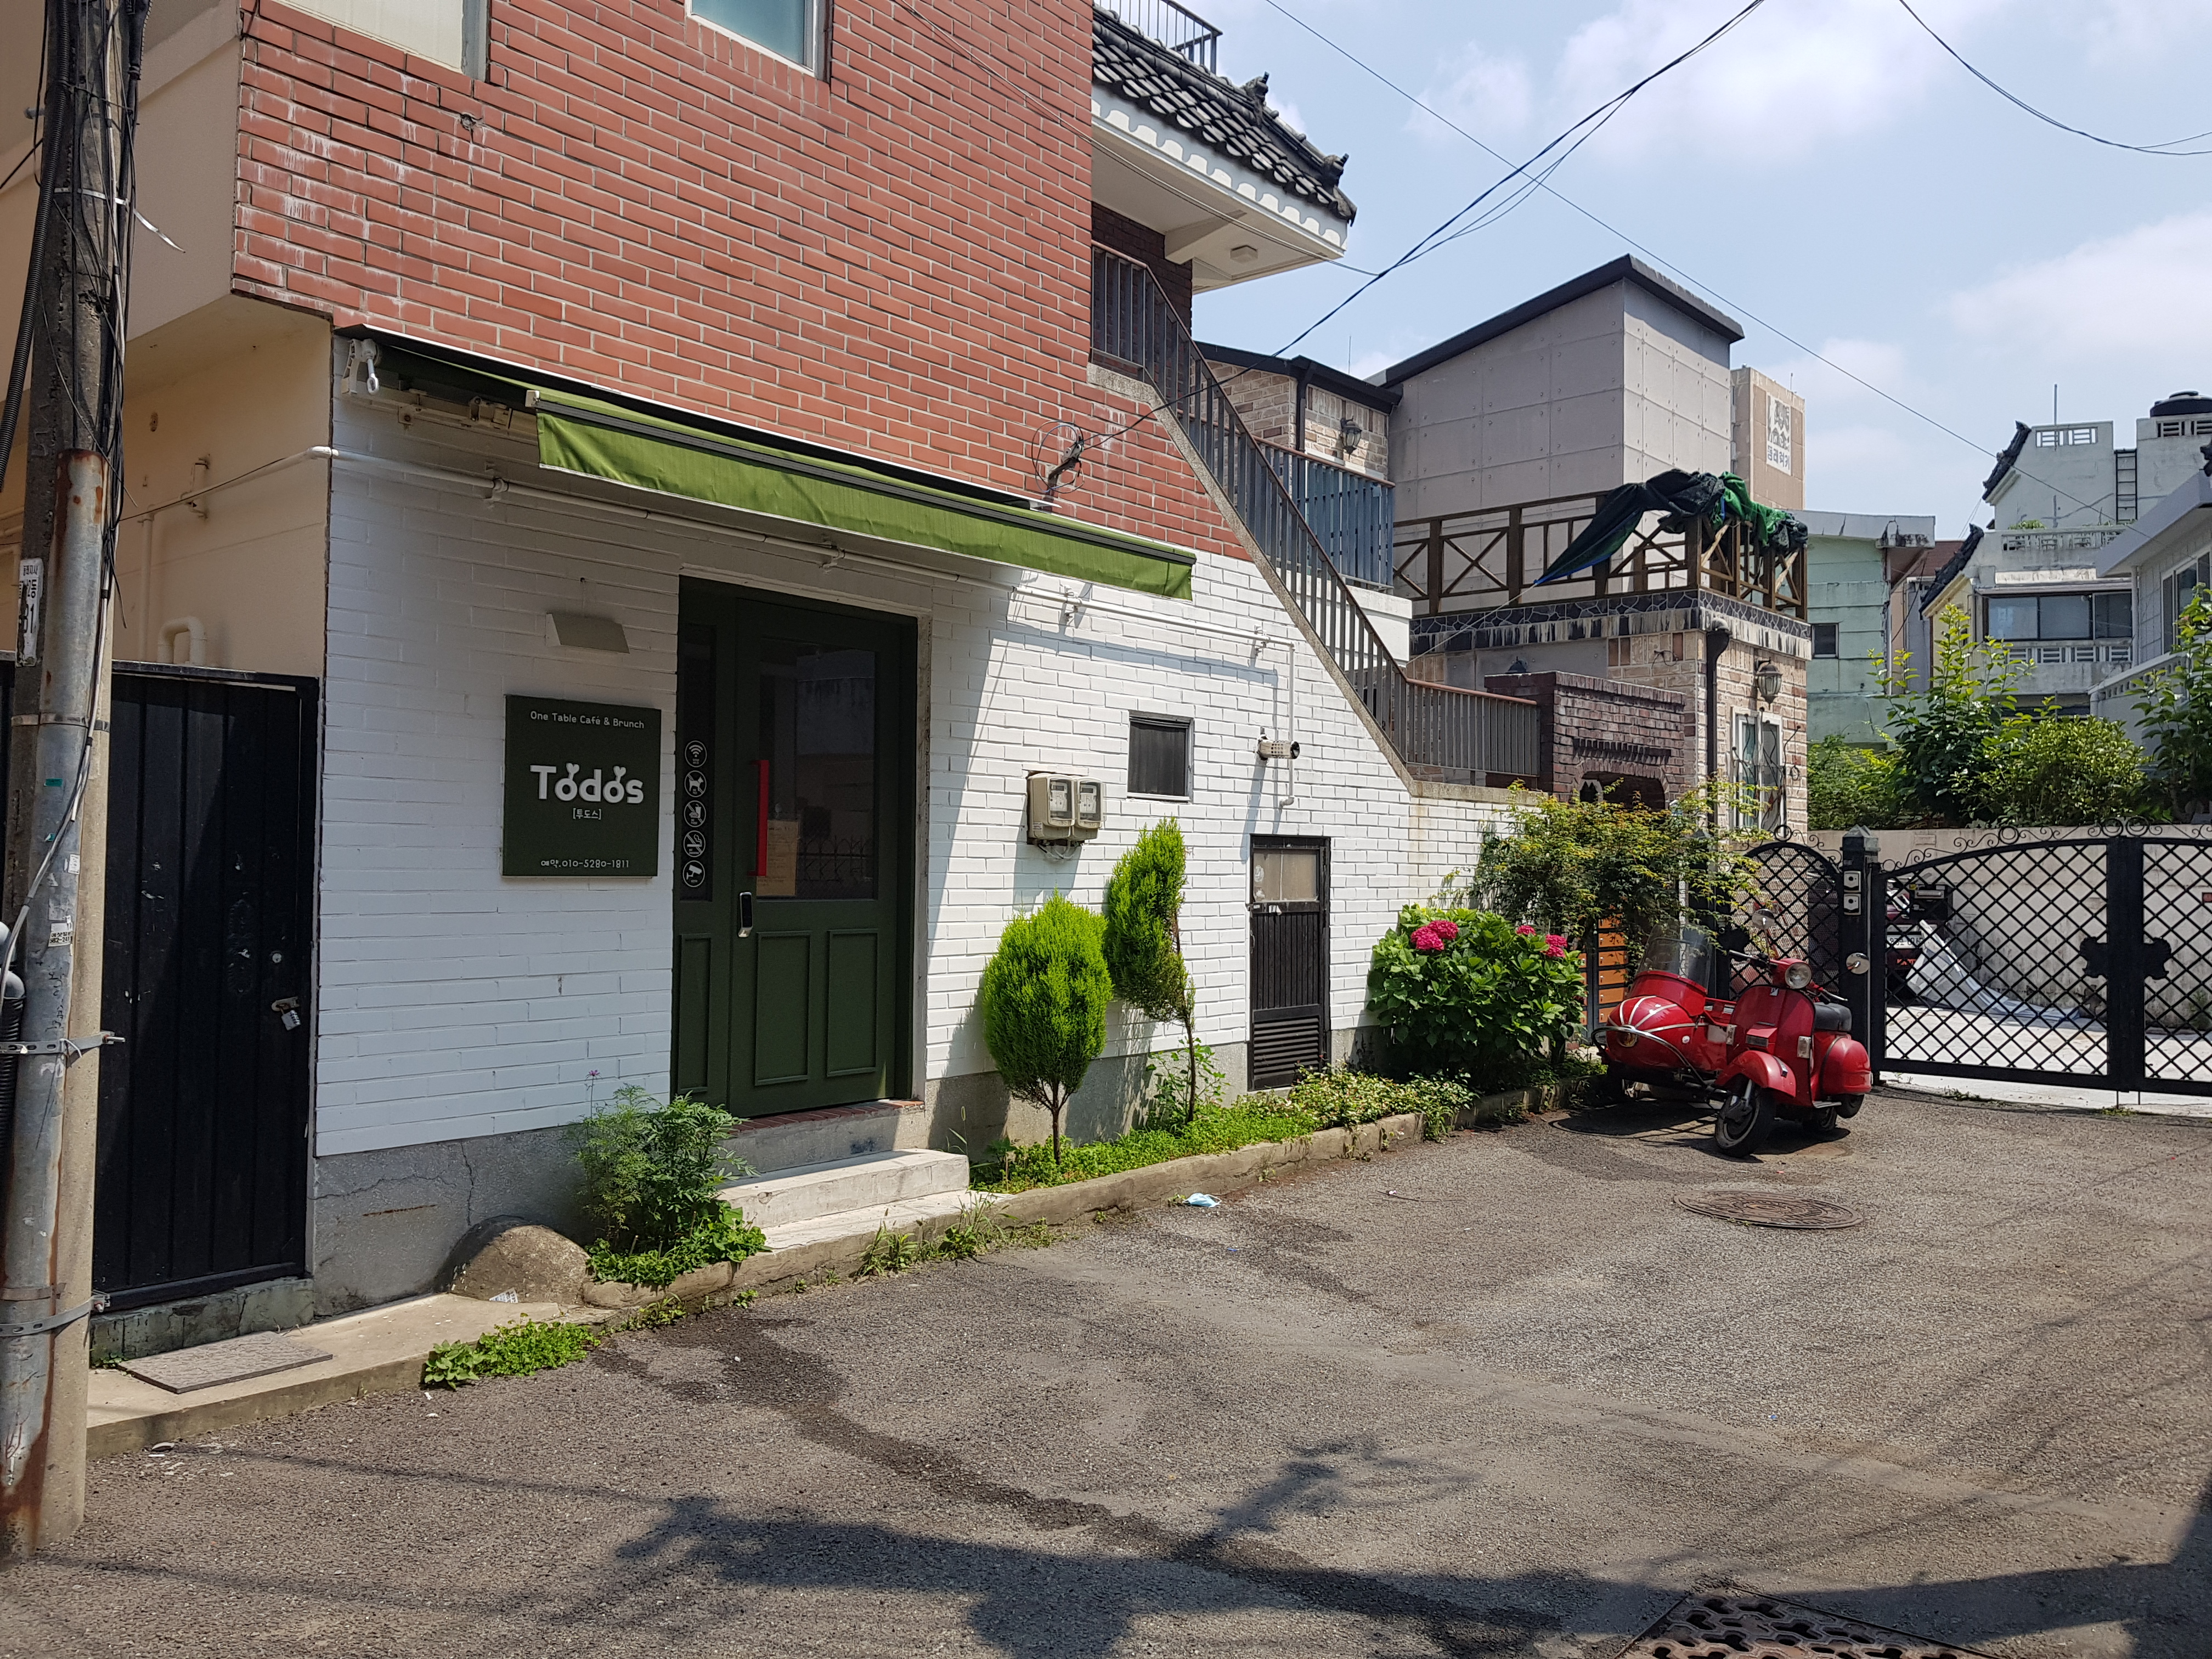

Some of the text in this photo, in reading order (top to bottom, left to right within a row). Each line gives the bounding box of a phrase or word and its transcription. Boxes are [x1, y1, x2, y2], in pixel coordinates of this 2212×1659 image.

[530, 710, 645, 729] One Table Café & Brunch
[530, 763, 644, 804] Todos
